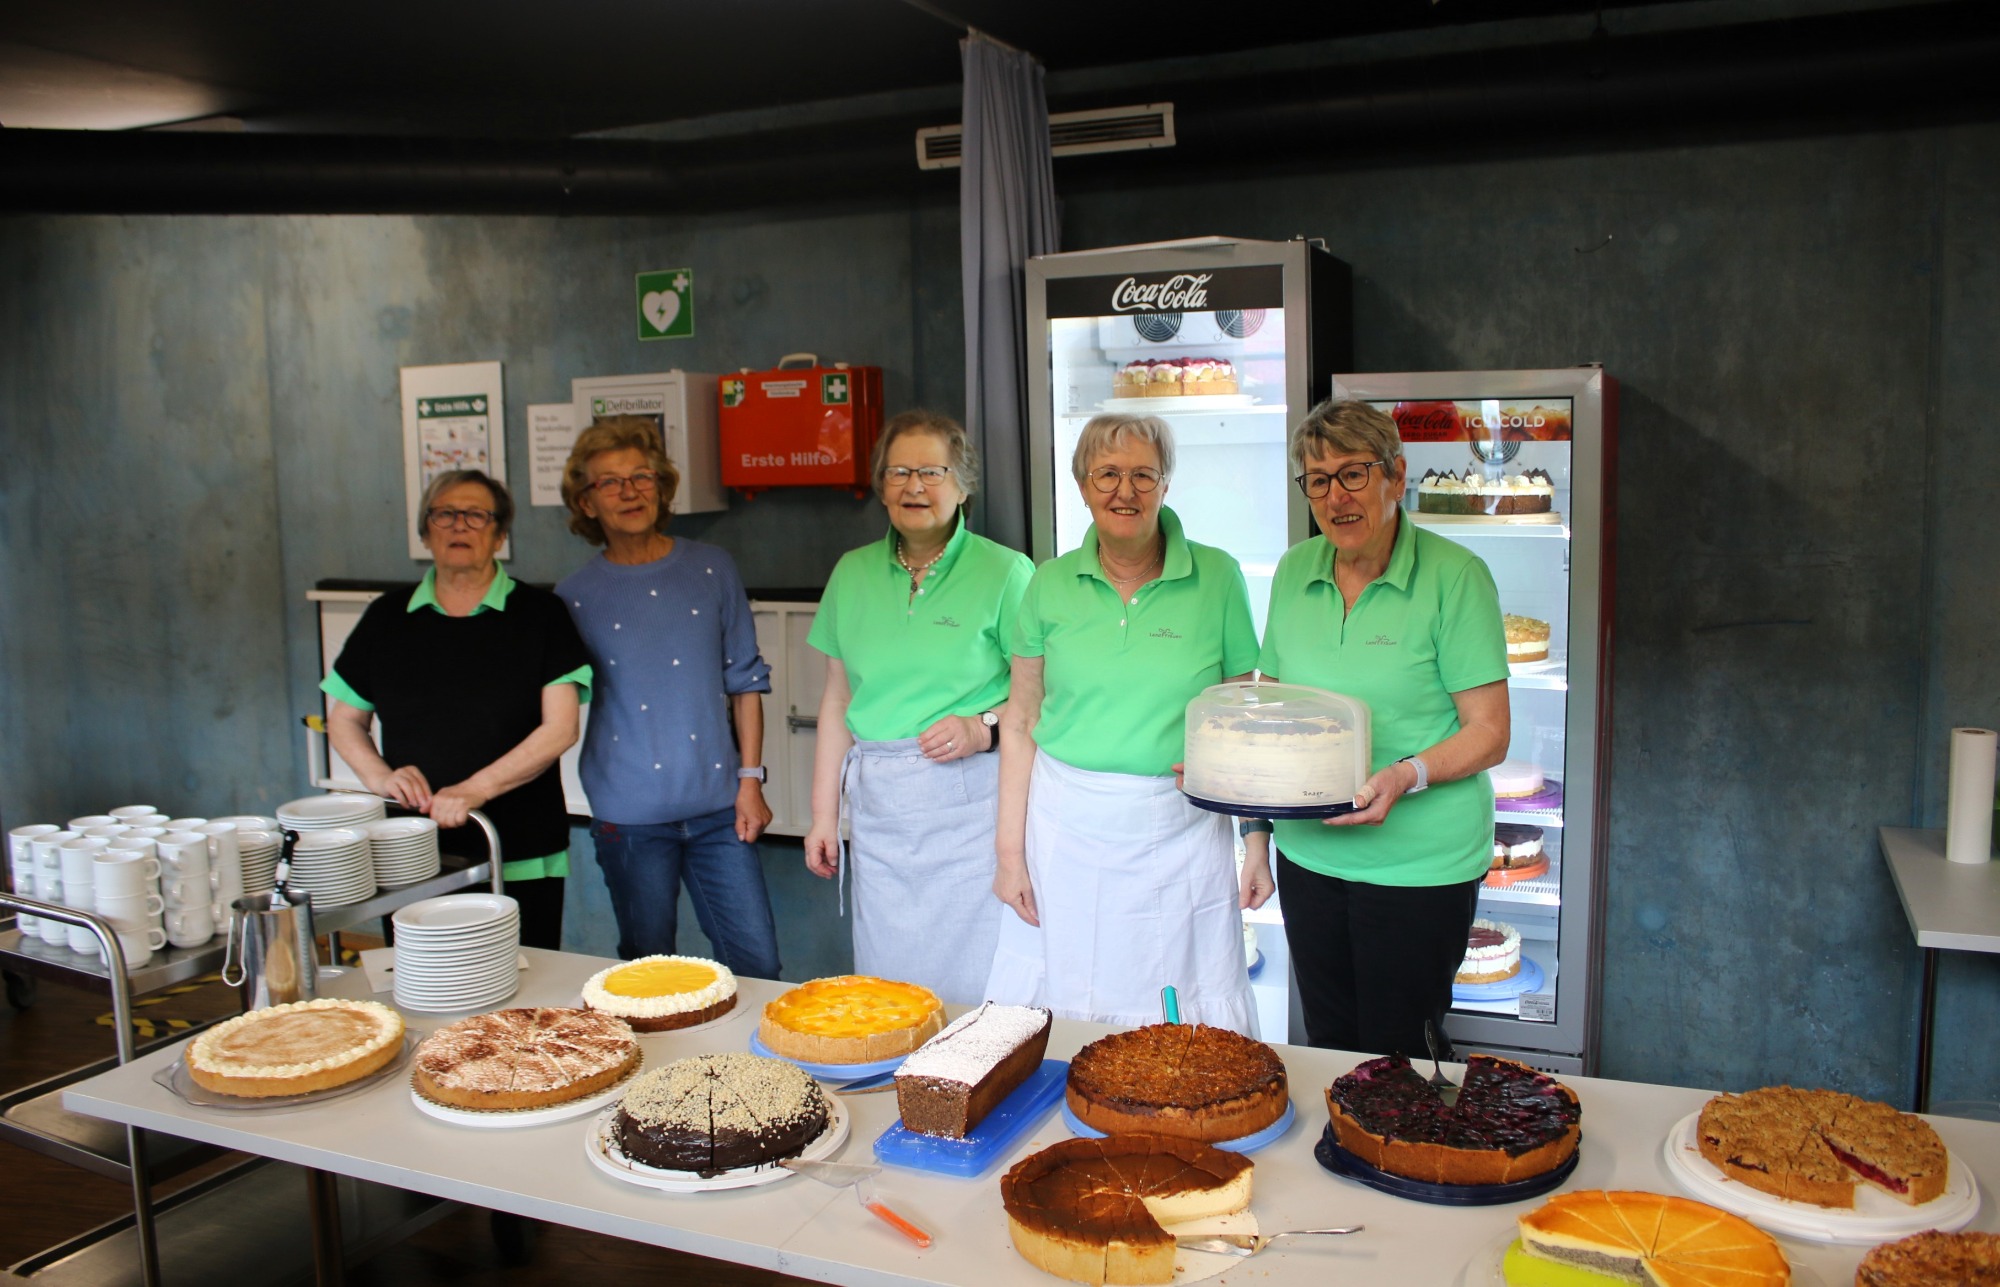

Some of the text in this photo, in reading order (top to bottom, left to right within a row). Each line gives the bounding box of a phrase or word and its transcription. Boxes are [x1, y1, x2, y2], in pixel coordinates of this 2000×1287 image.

[606, 398, 662, 411] Defibrillator
[1500, 415, 1545, 428] COLD
[741, 452, 832, 467] Erste Hilfe
